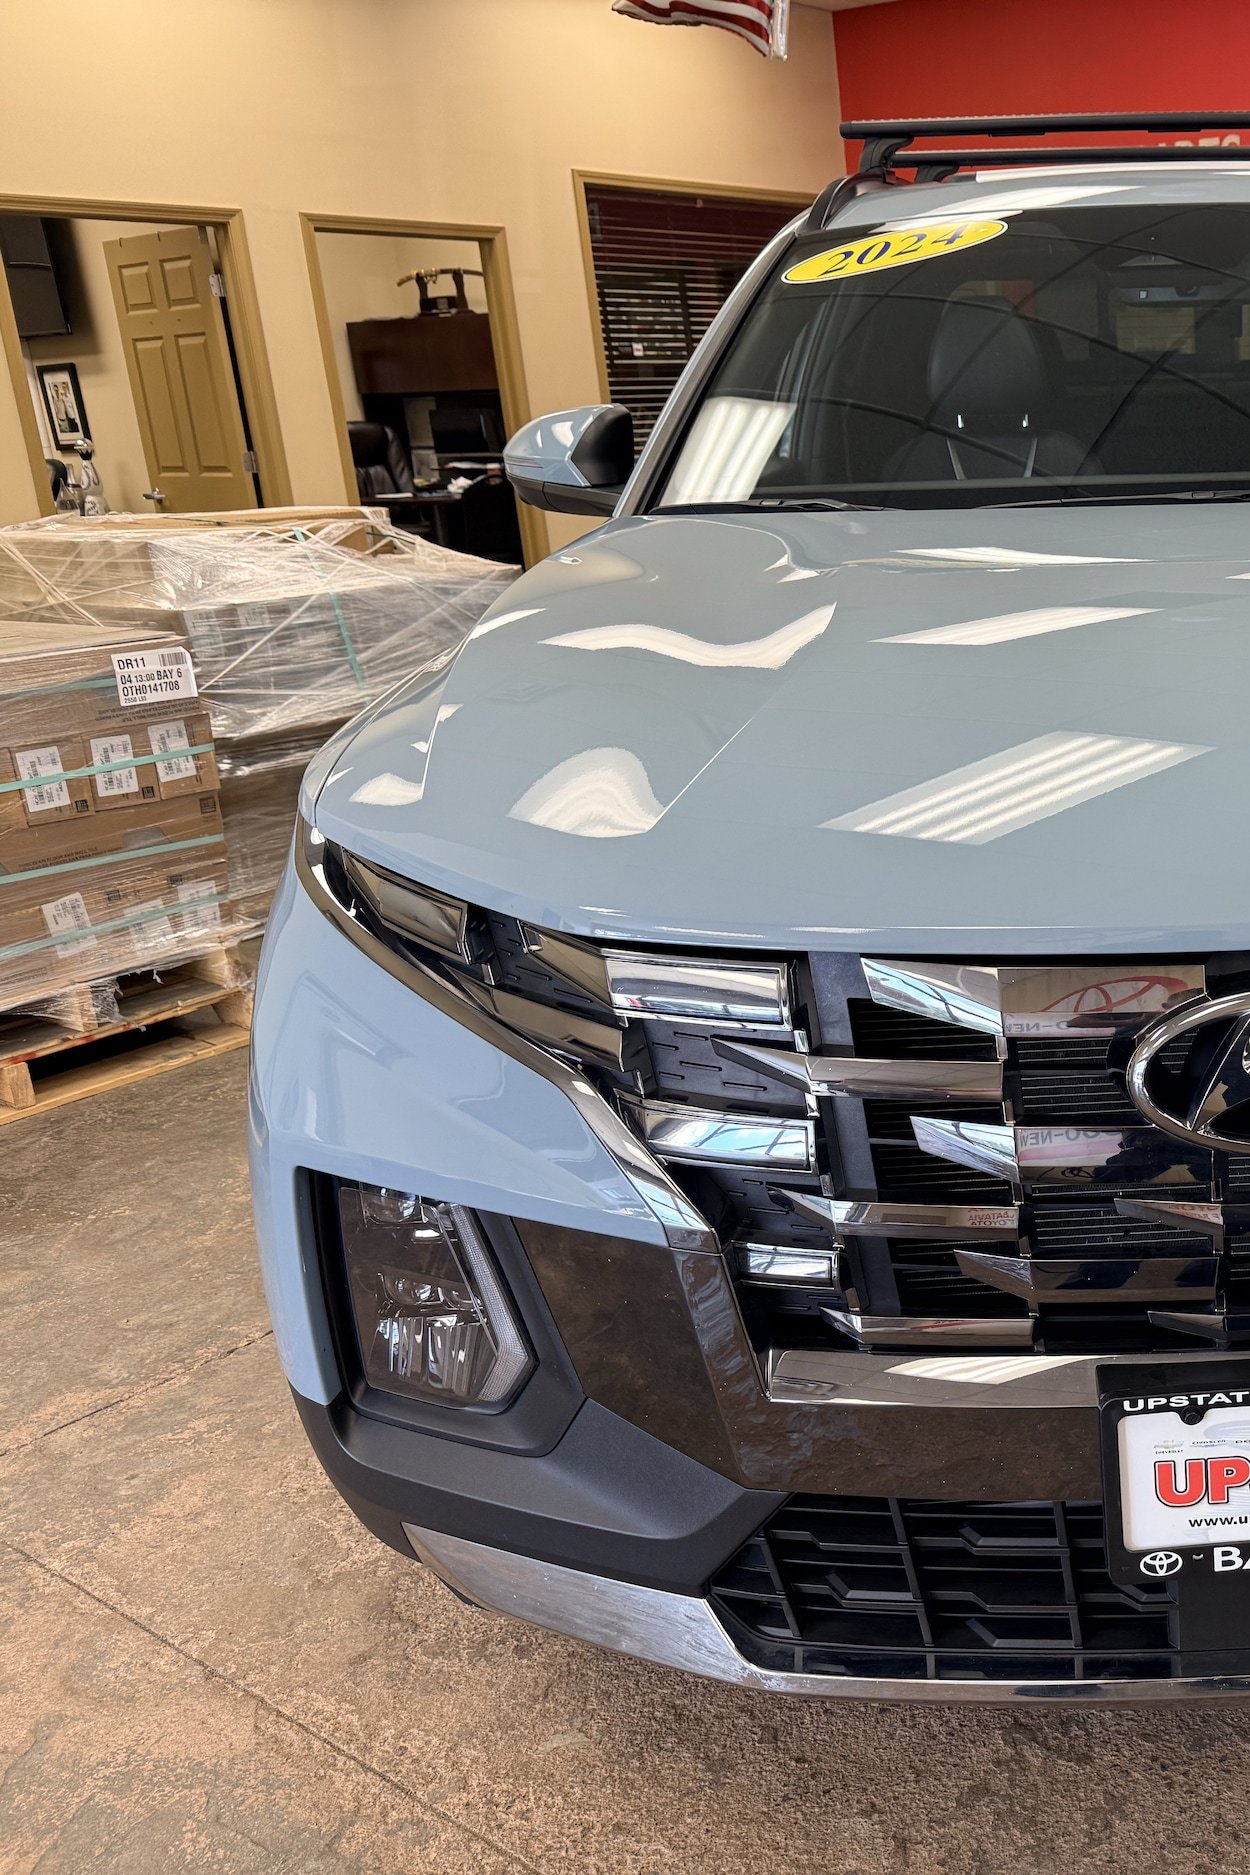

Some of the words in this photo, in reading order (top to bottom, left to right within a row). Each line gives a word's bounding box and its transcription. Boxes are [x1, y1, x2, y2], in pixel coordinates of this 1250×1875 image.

[817, 222, 969, 277] 2024
[117, 657, 146, 670] DR11
[120, 674, 132, 685] 04
[134, 673, 156, 683] 13:00
[156, 669, 174, 680] BAY
[176, 668, 183, 678] 6
